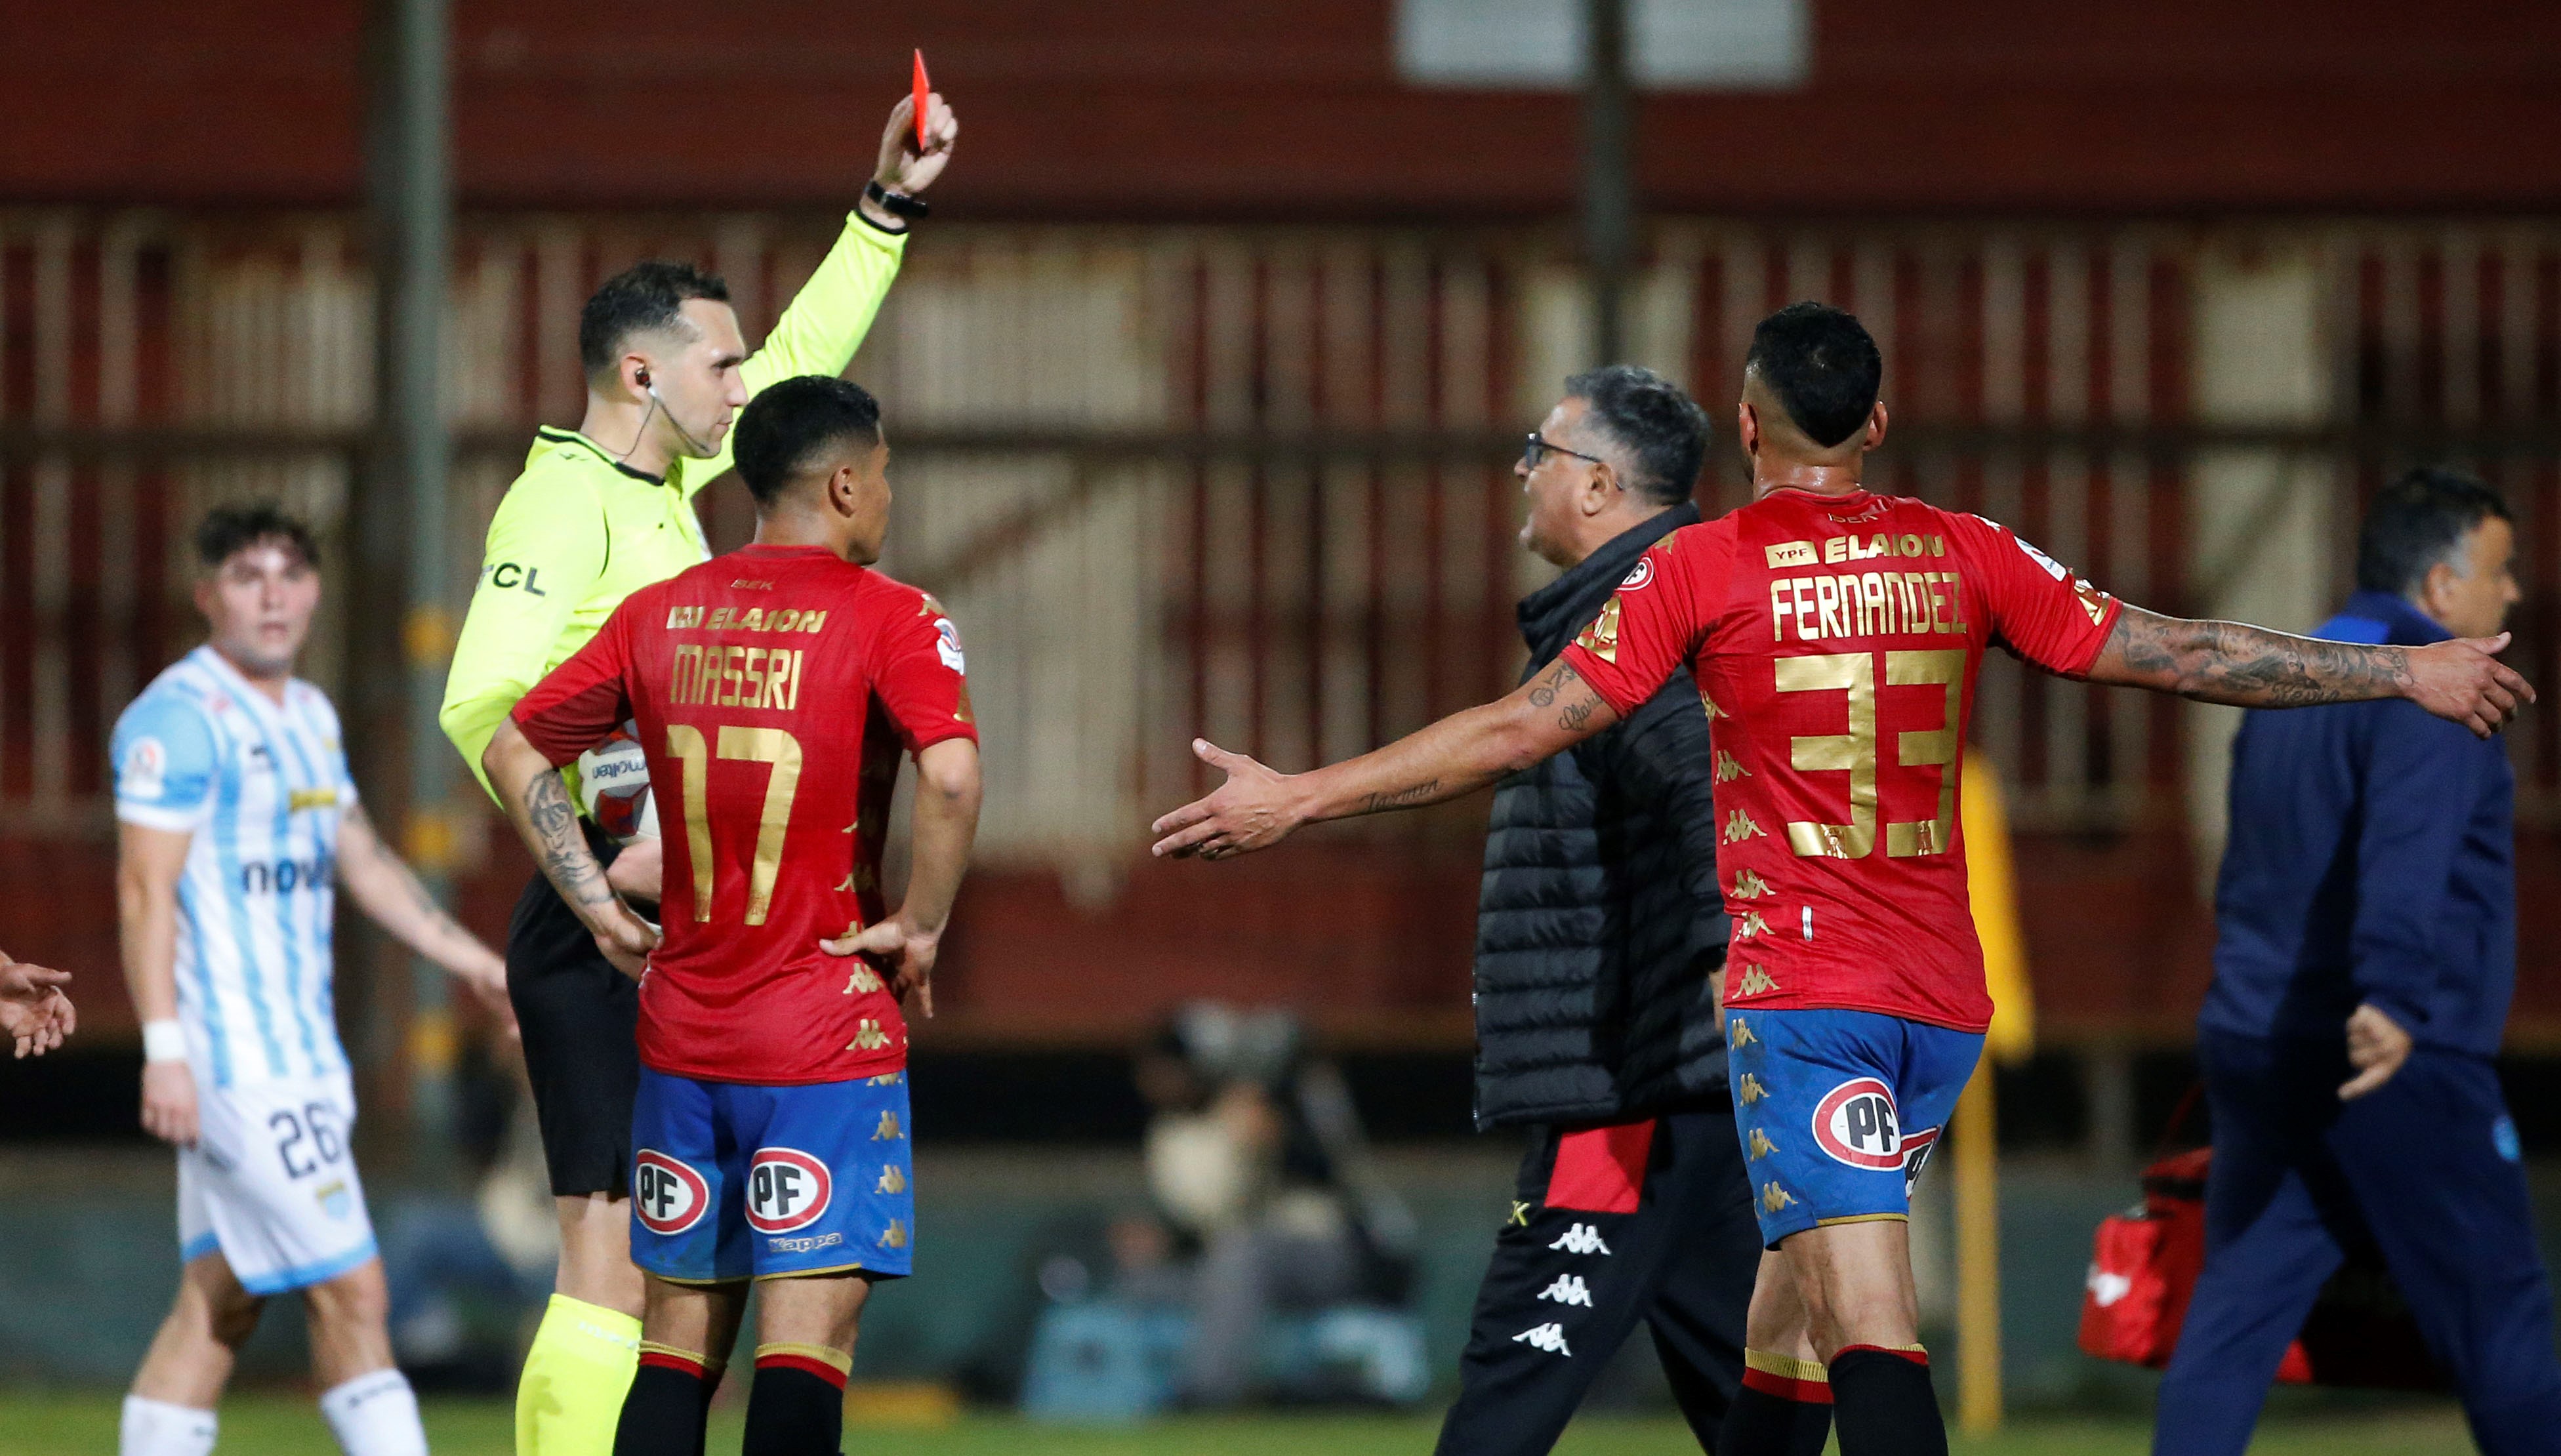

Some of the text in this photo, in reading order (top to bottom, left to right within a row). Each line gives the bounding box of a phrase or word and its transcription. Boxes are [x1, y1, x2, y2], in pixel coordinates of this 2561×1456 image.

[1775, 533, 1946, 565] YPF ELAION
[476, 562, 546, 597] TCL
[705, 607, 829, 634] ELAION
[1771, 571, 1967, 642] FERNANDEZ
[670, 644, 804, 710] MASSRI
[592, 759, 647, 779] molten
[1774, 649, 1967, 860] 33
[665, 724, 804, 926] 17
[268, 1102, 340, 1179] 26
[1845, 1096, 1895, 1152] PF
[640, 1165, 677, 1218] PF
[753, 1165, 801, 1216] PF
[768, 1232, 842, 1253] Kappa
